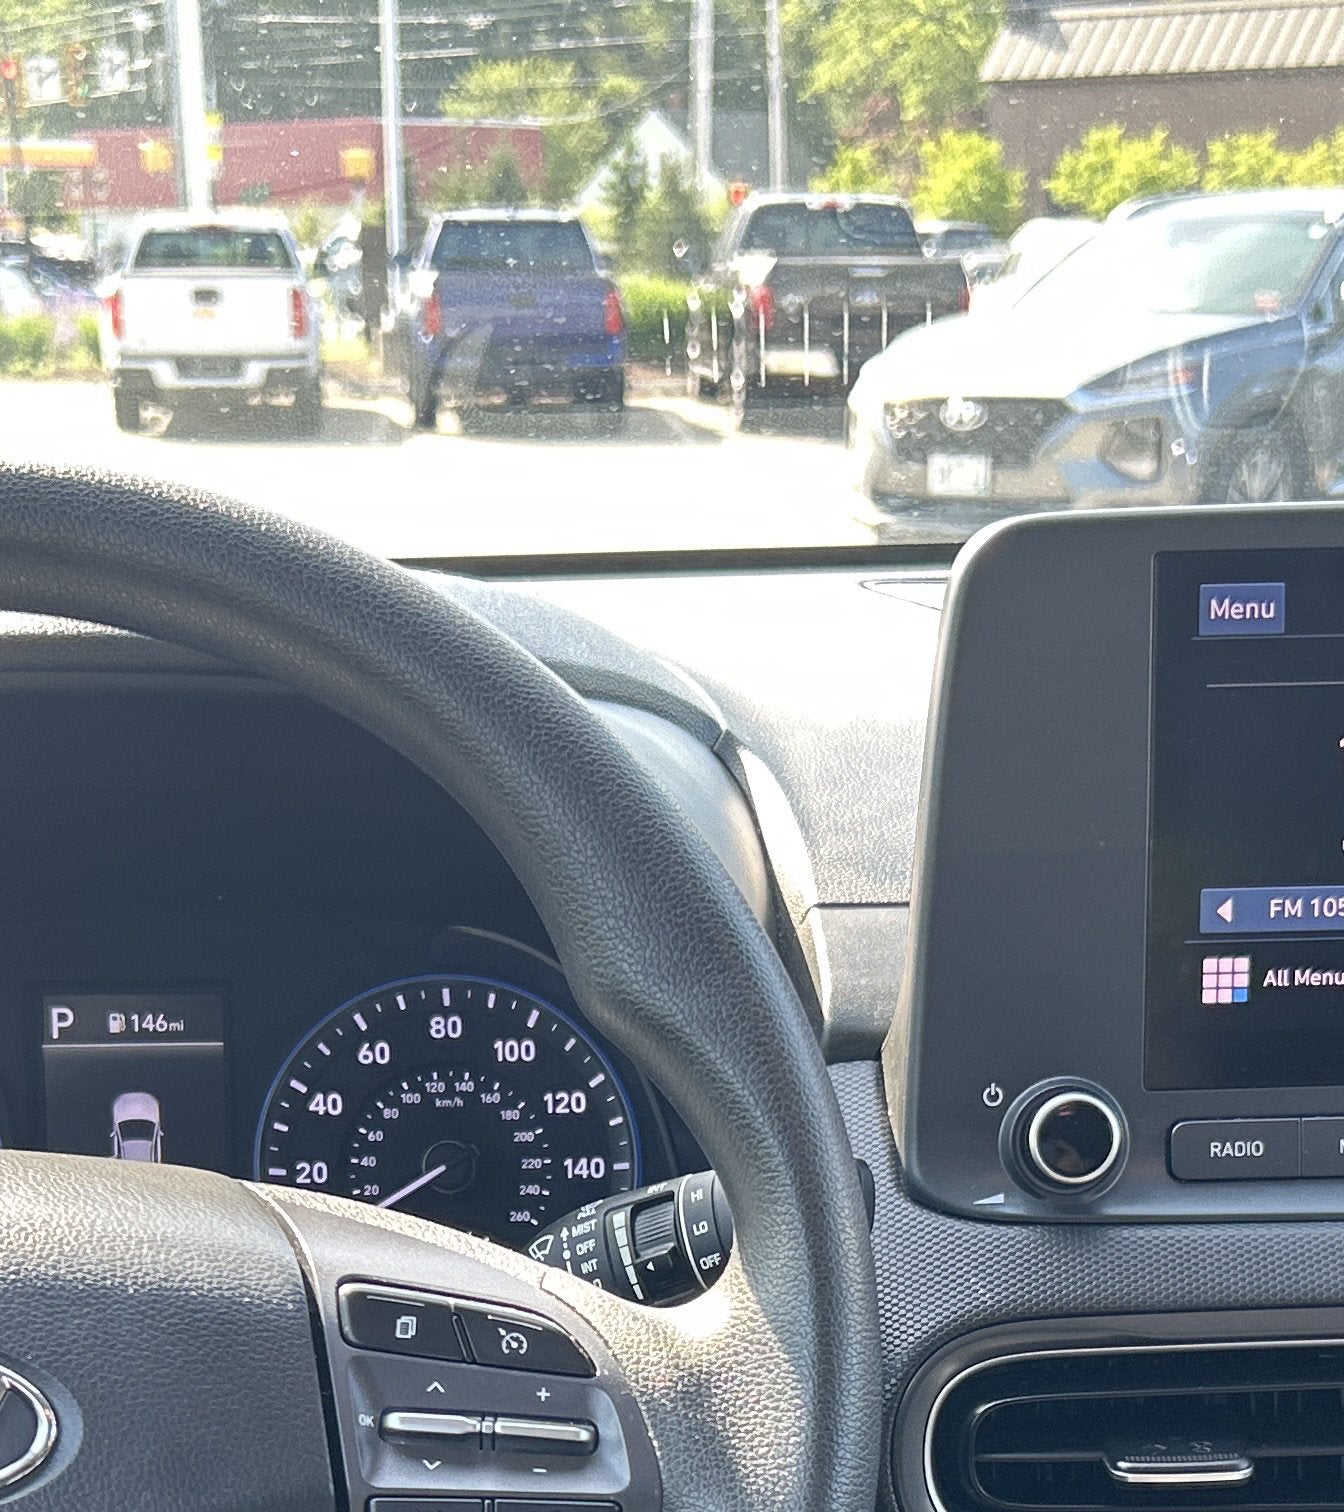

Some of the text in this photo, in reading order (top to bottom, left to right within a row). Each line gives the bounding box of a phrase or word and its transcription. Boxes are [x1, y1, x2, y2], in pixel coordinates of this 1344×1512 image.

[1209, 597, 1276, 620] Menu
[1268, 898, 1303, 919] FM
[1262, 968, 1289, 988] All
[50, 1007, 74, 1040] P
[429, 1015, 462, 1039] 80
[357, 1042, 391, 1065] 60
[493, 1039, 536, 1062] 100
[425, 1080, 445, 1092] 120
[454, 1080, 475, 1092] 140
[308, 1092, 343, 1116] 40
[400, 1092, 421, 1104] 100
[435, 1096, 464, 1109] km/h
[480, 1092, 500, 1104] 160
[543, 1091, 586, 1115] 120
[383, 1107, 399, 1119] 80
[500, 1109, 520, 1121] 180
[367, 1130, 383, 1142] 60
[513, 1131, 535, 1143] 200
[1209, 1139, 1264, 1158] RADIO
[360, 1155, 376, 1168] 40
[521, 1158, 542, 1169] 220
[563, 1157, 606, 1180] 140
[295, 1161, 328, 1184] 20
[363, 1184, 380, 1196] 20
[519, 1184, 541, 1196] 240
[690, 1188, 704, 1203] HI
[509, 1210, 531, 1223] 260
[571, 1219, 598, 1238] MIST
[692, 1220, 709, 1236] LO
[575, 1238, 596, 1256] OFF
[580, 1258, 599, 1275] INT
[699, 1252, 722, 1270] OFF
[358, 1414, 375, 1428] OK
